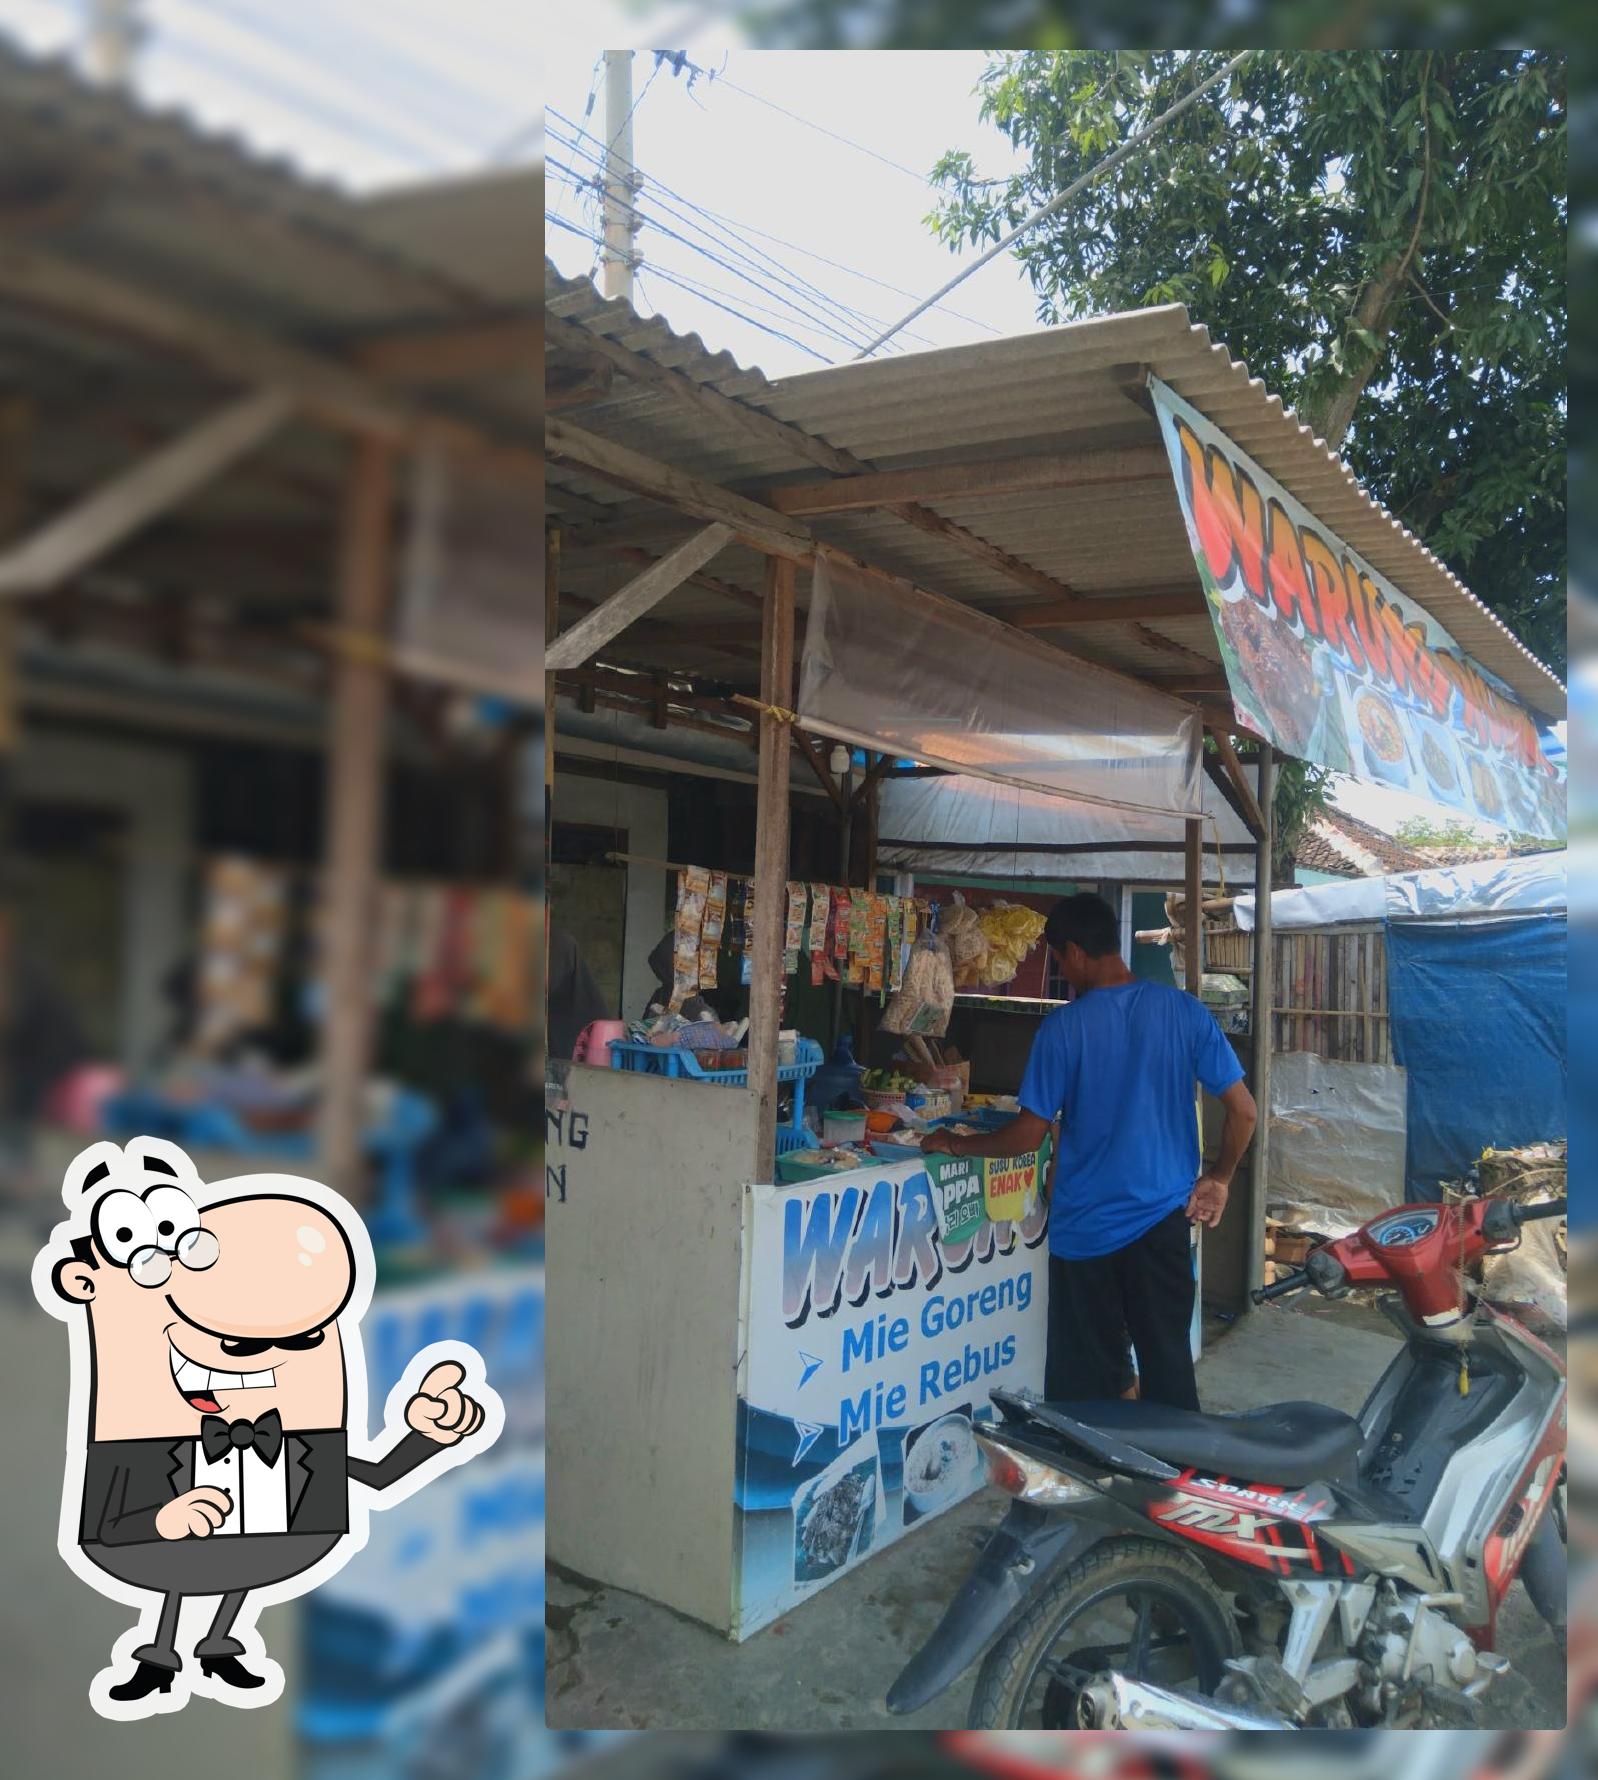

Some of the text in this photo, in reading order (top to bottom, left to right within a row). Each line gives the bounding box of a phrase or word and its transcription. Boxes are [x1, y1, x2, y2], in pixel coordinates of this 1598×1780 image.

[940, 1161, 970, 1180] MARI
[989, 1152, 1036, 1175] SUSU KOREA
[990, 1172, 1022, 1198] ENAK
[782, 1170, 1049, 1329] WAR
[840, 1271, 1033, 1374] Mie Goreng
[838, 1334, 1017, 1448] Mie Rebus
